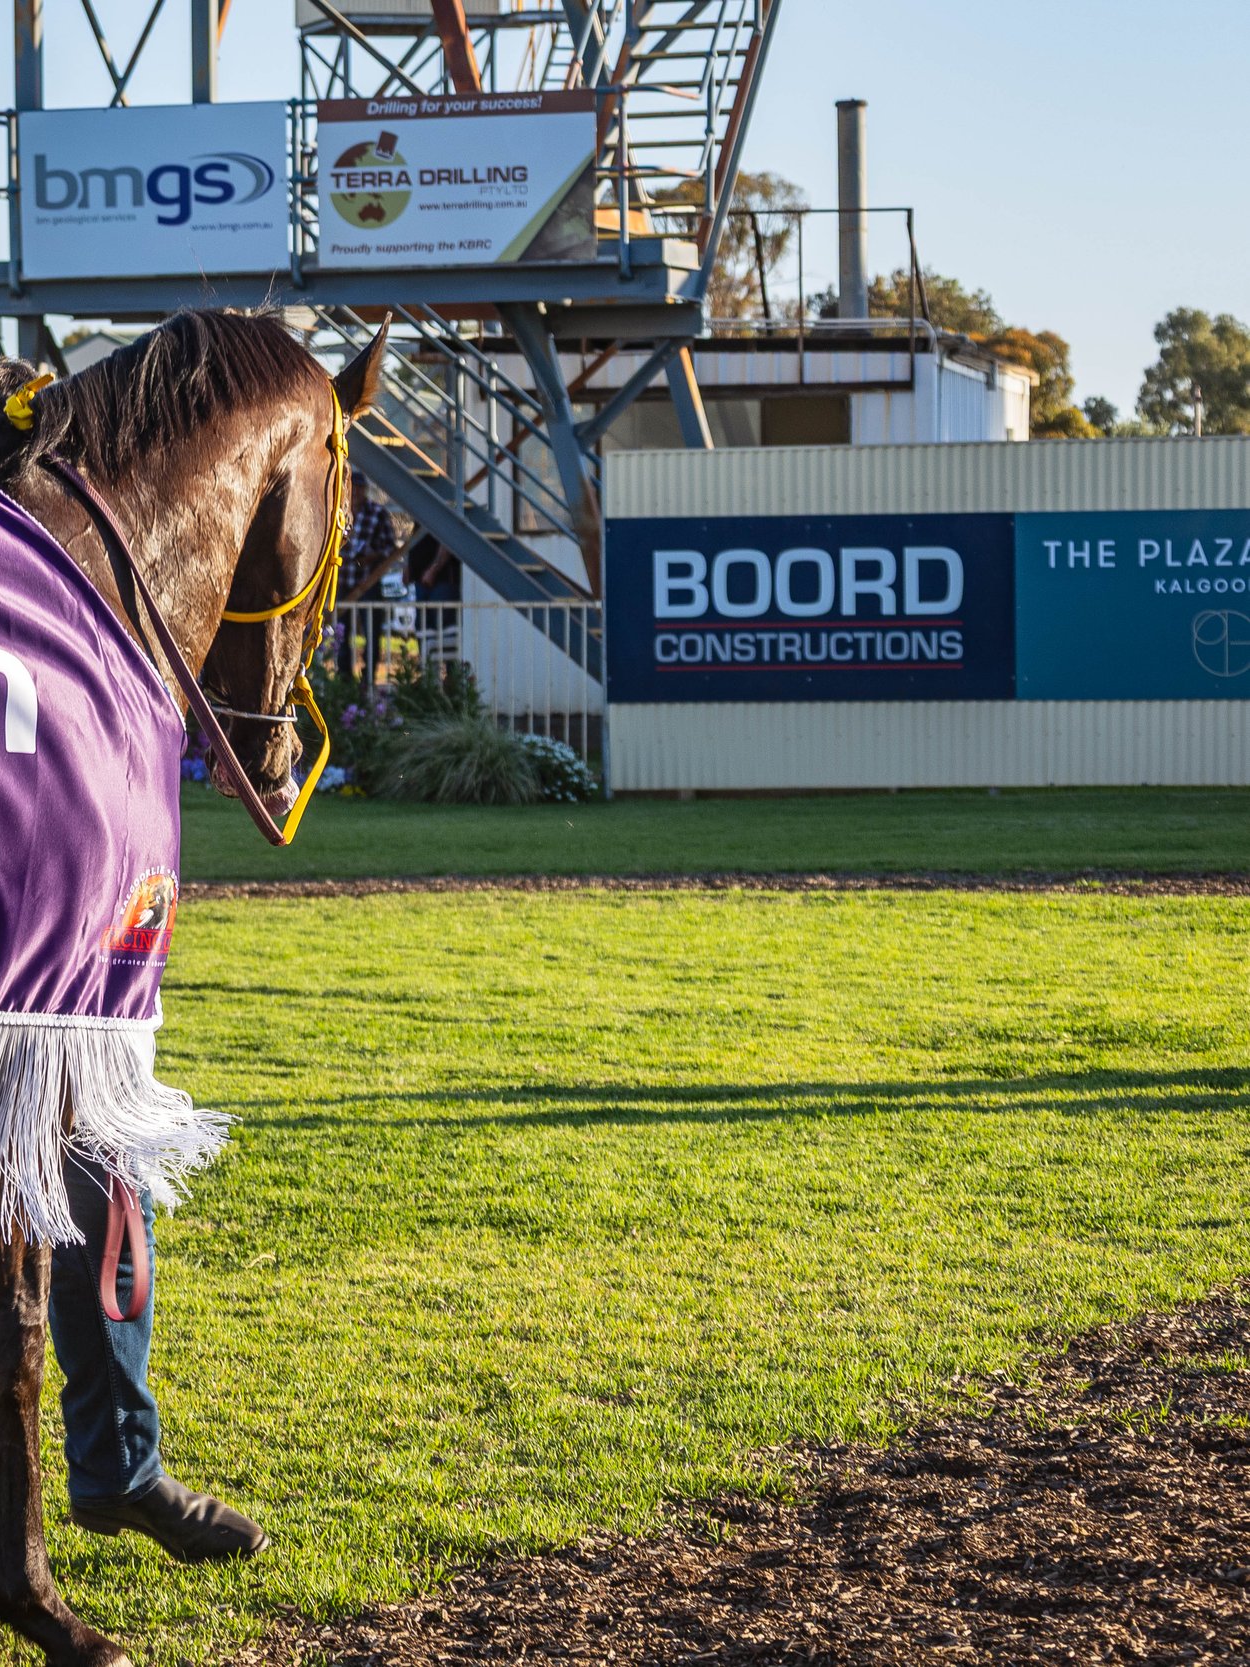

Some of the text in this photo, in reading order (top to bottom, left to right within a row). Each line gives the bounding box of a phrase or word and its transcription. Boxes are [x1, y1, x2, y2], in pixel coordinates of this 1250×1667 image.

[366, 96, 543, 116] Drilling for your success!
[330, 166, 528, 189] TERRA DRILLING
[34, 154, 236, 226] bmgs
[419, 200, 528, 211] www.terradrilling.com.au
[331, 239, 492, 255] Proudly supporting the KBRC
[1042, 539, 1116, 569] THE
[654, 548, 964, 618] BOORD
[1154, 577, 1250, 594] KALGOO
[655, 630, 964, 663] CONSTRUCTIONS
